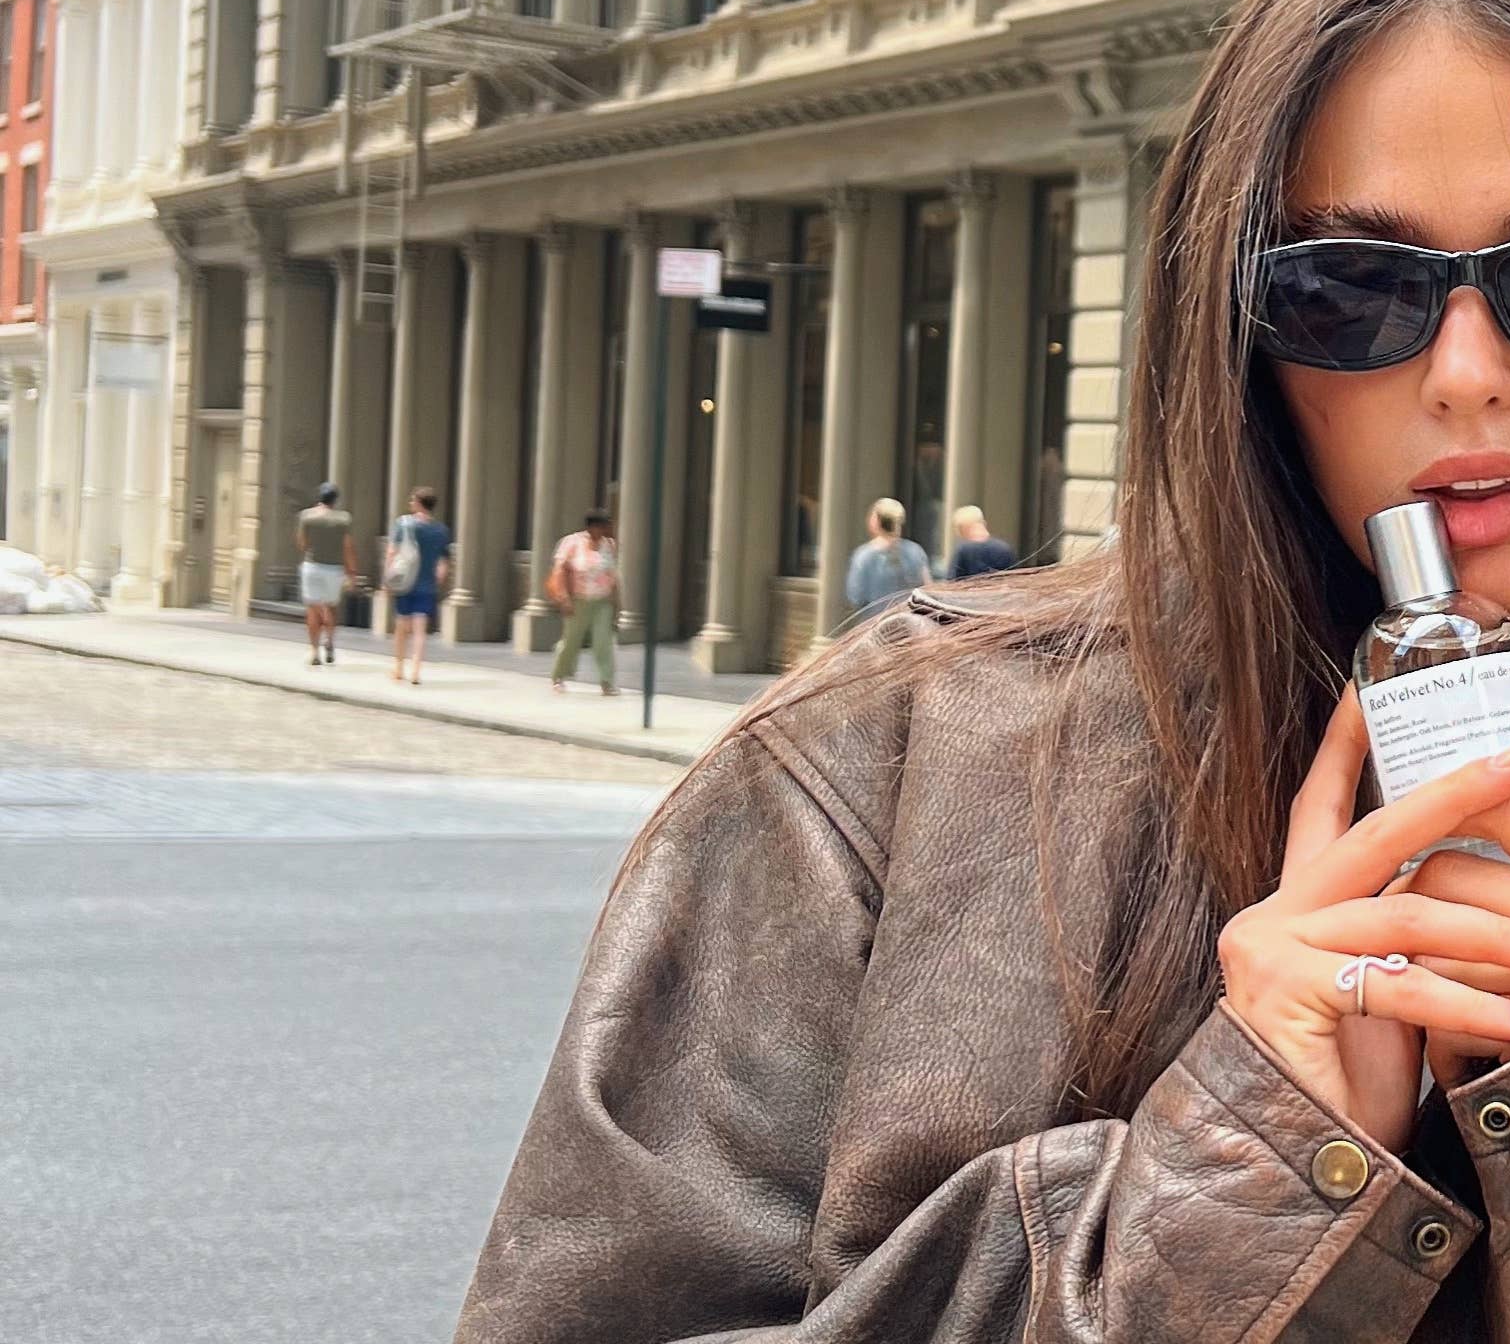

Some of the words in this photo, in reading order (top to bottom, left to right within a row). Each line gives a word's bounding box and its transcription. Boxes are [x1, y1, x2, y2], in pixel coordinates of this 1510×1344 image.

[1369, 694, 1388, 712] Red
[1388, 682, 1430, 704] Velvet
[1478, 670, 1495, 681] eau
[1497, 665, 1507, 677] de
